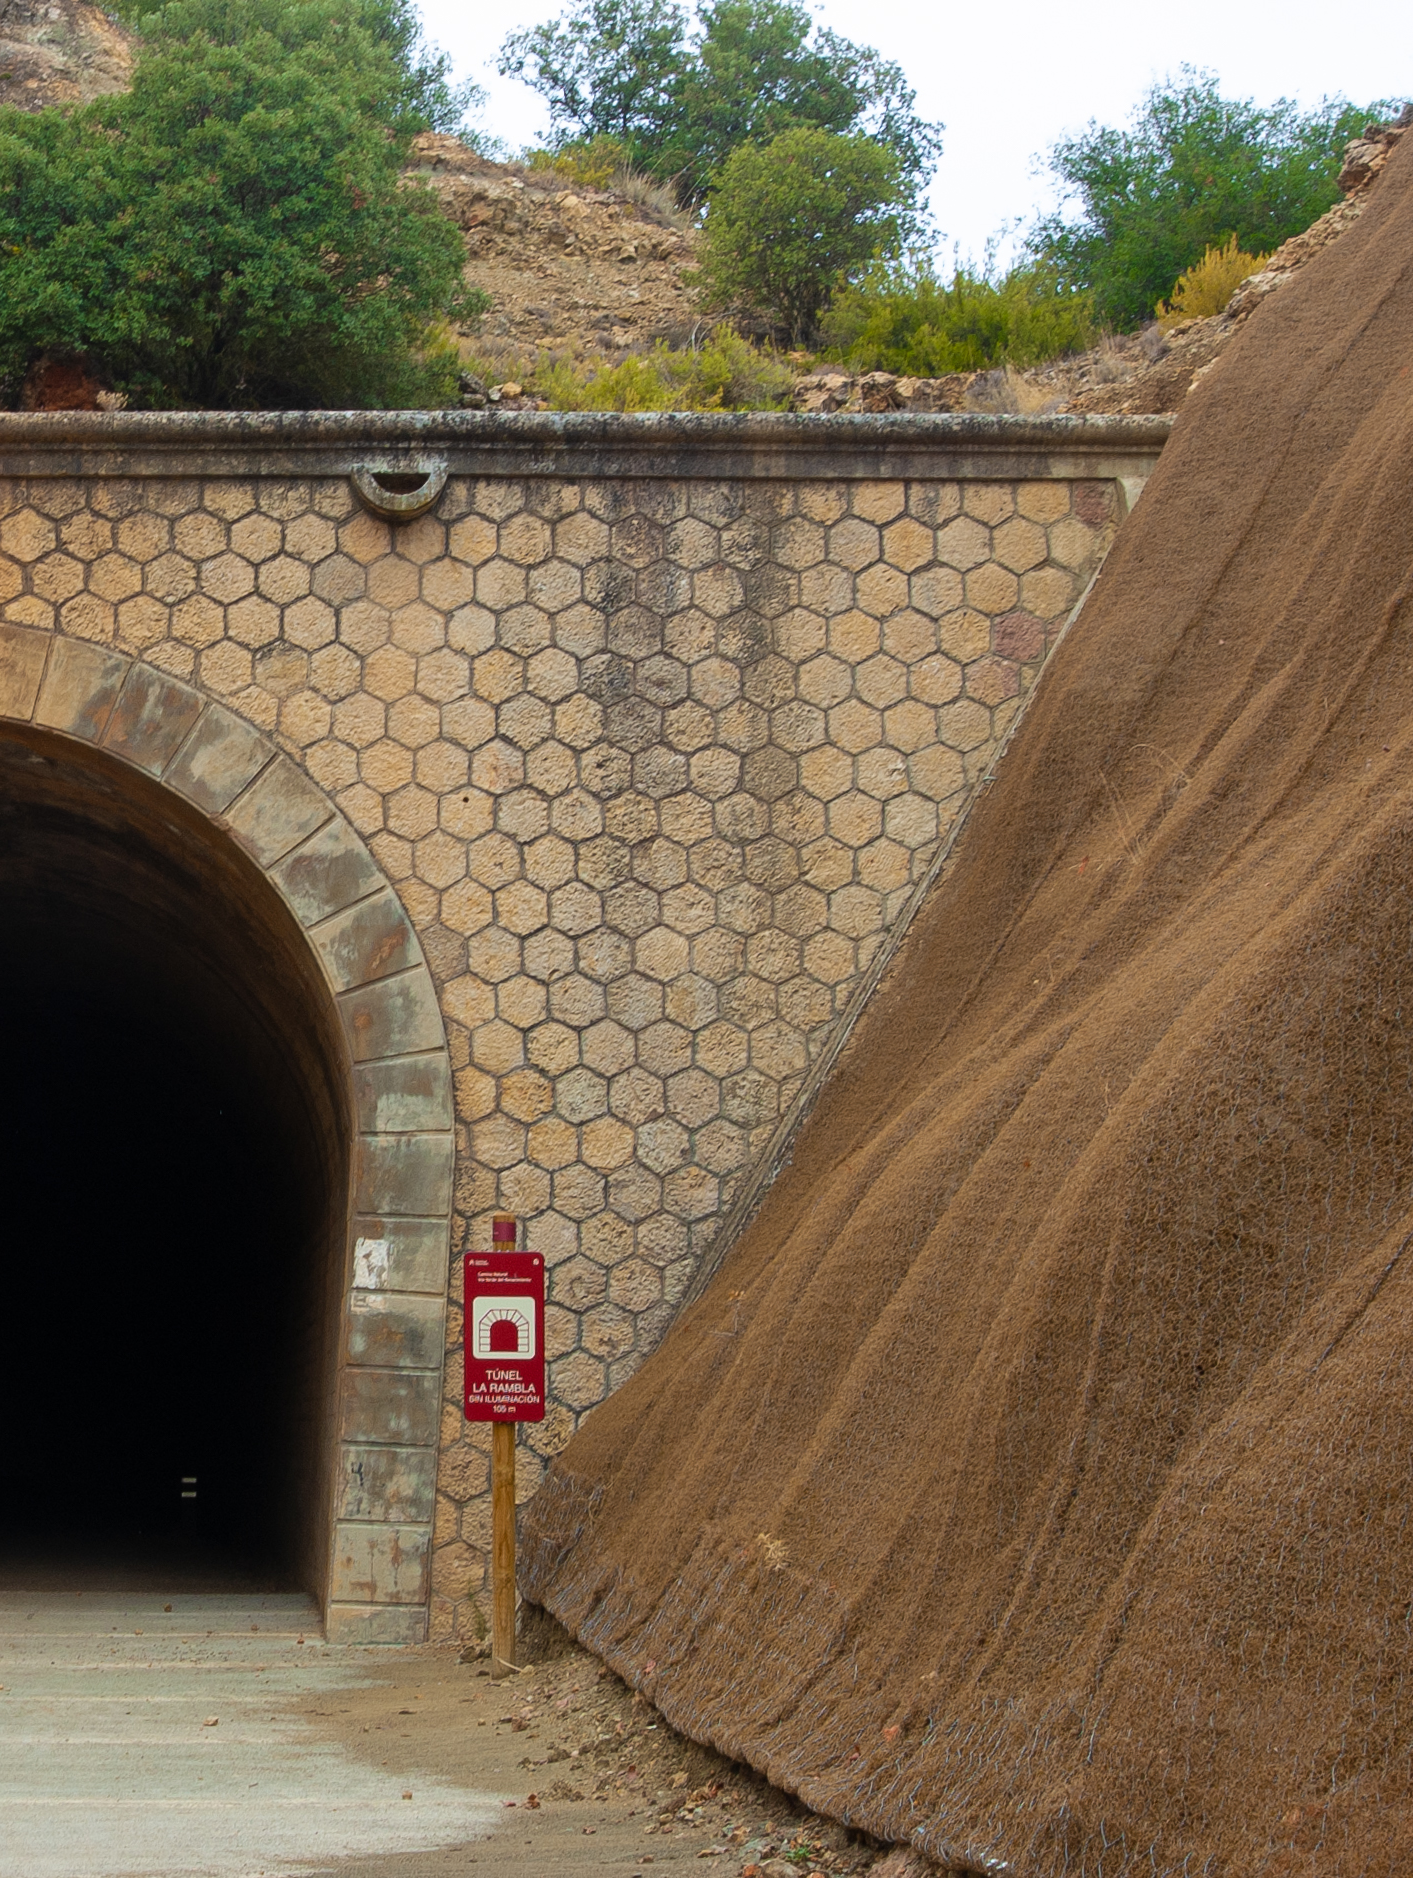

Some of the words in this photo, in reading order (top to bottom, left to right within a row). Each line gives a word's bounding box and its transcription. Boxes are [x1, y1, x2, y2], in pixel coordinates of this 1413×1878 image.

[485, 1368, 523, 1380] TÚNEL
[473, 1383, 487, 1393] LA
[489, 1383, 536, 1393] RAMBLA
[469, 1394, 483, 1403] SIN
[485, 1393, 540, 1403] ILUMINACIÓN
